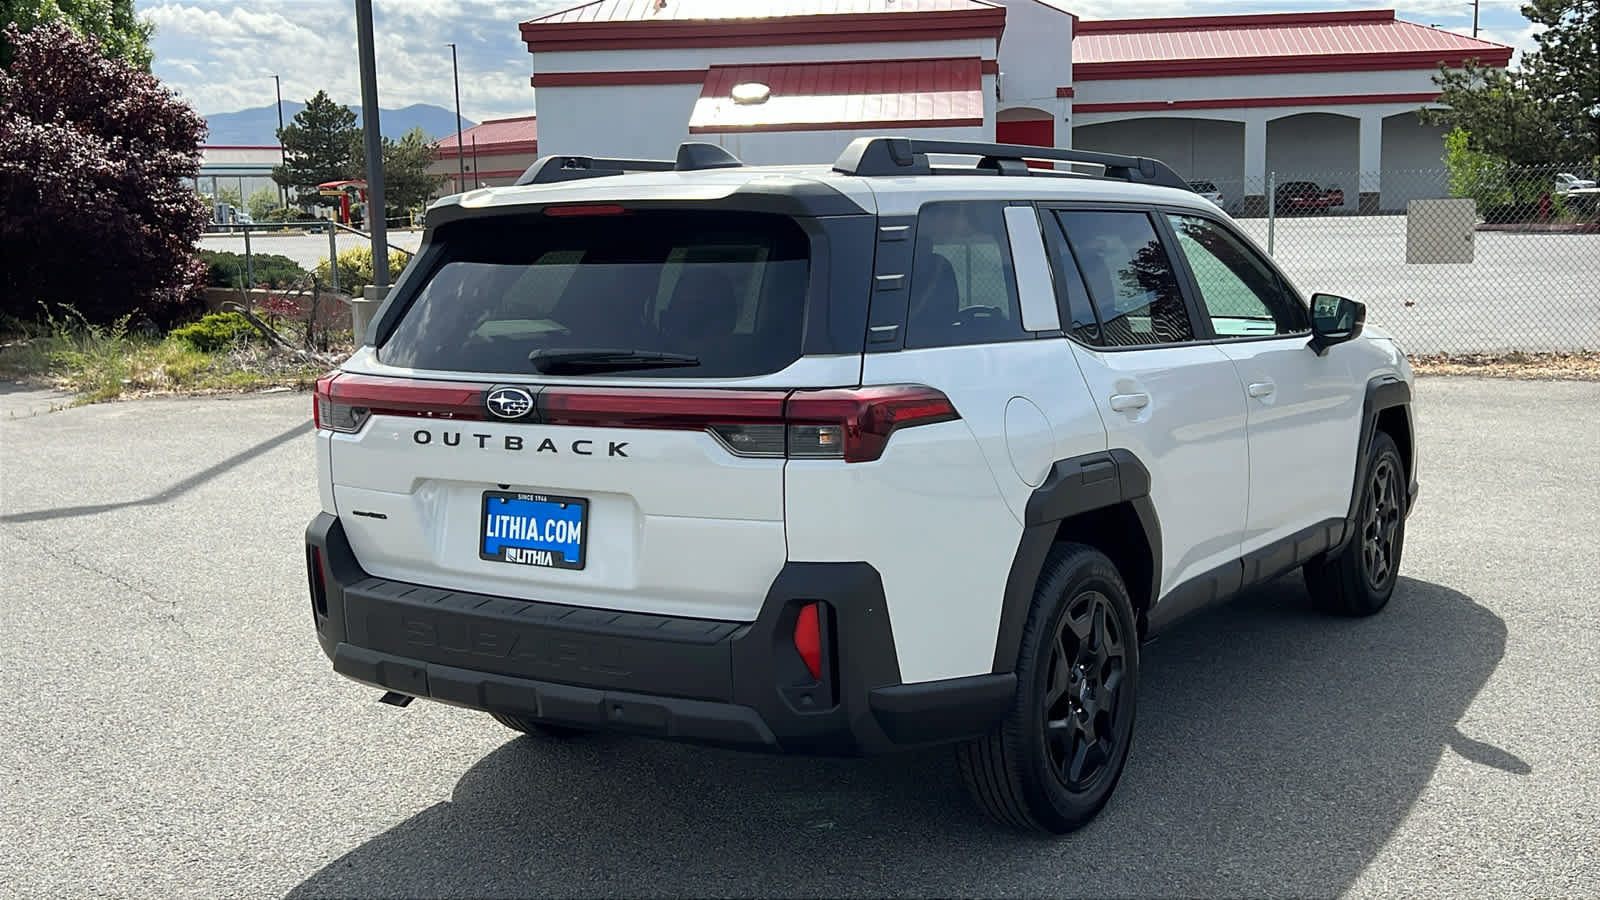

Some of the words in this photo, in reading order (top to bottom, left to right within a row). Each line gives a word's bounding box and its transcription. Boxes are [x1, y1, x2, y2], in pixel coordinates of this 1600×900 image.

[413, 429, 629, 458] OUTBACK
[518, 493, 534, 502] SINCE
[486, 514, 582, 545] LITHIA.COM
[517, 548, 553, 567] LITHIA
